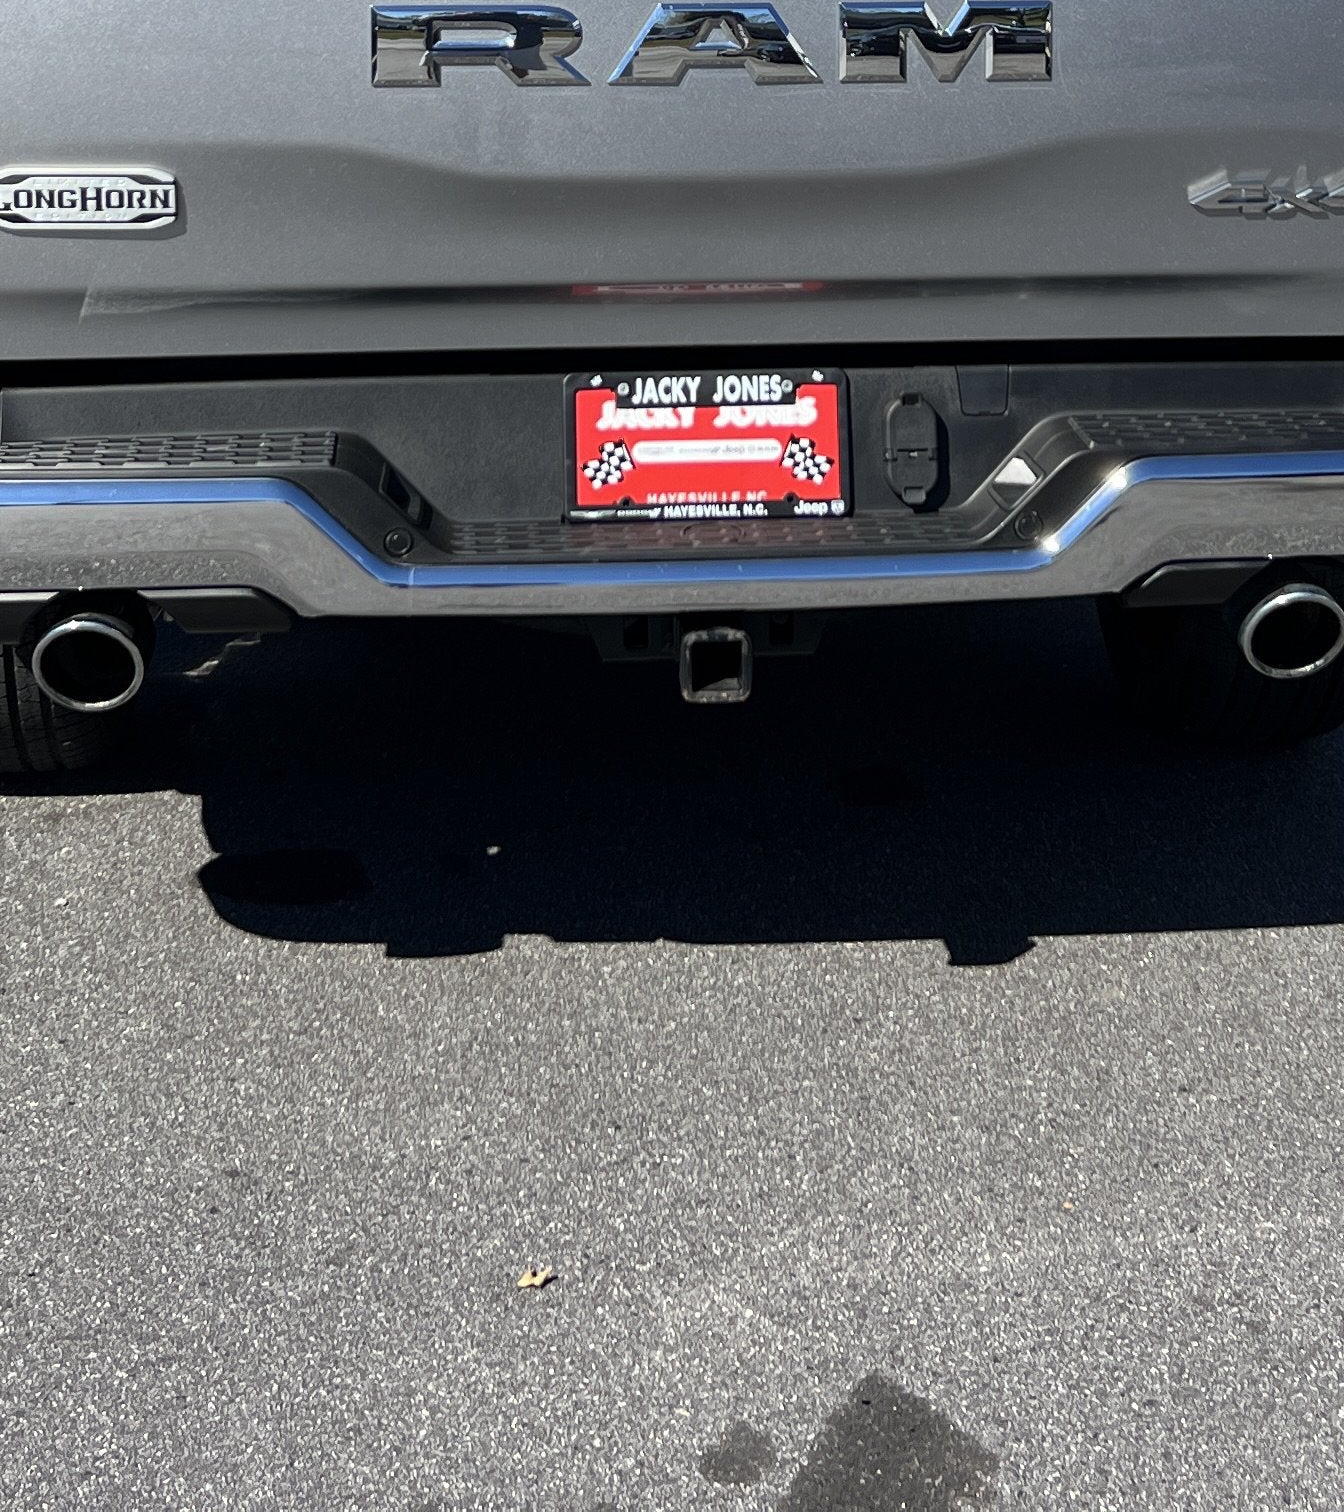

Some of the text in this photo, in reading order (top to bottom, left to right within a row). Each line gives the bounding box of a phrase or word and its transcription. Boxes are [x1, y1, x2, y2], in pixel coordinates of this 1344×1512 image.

[370, 0, 1054, 87] RAM
[632, 374, 783, 405] JACKY JONES
[664, 504, 741, 519] HAYESVILLE,
[794, 500, 828, 516] Jeep
